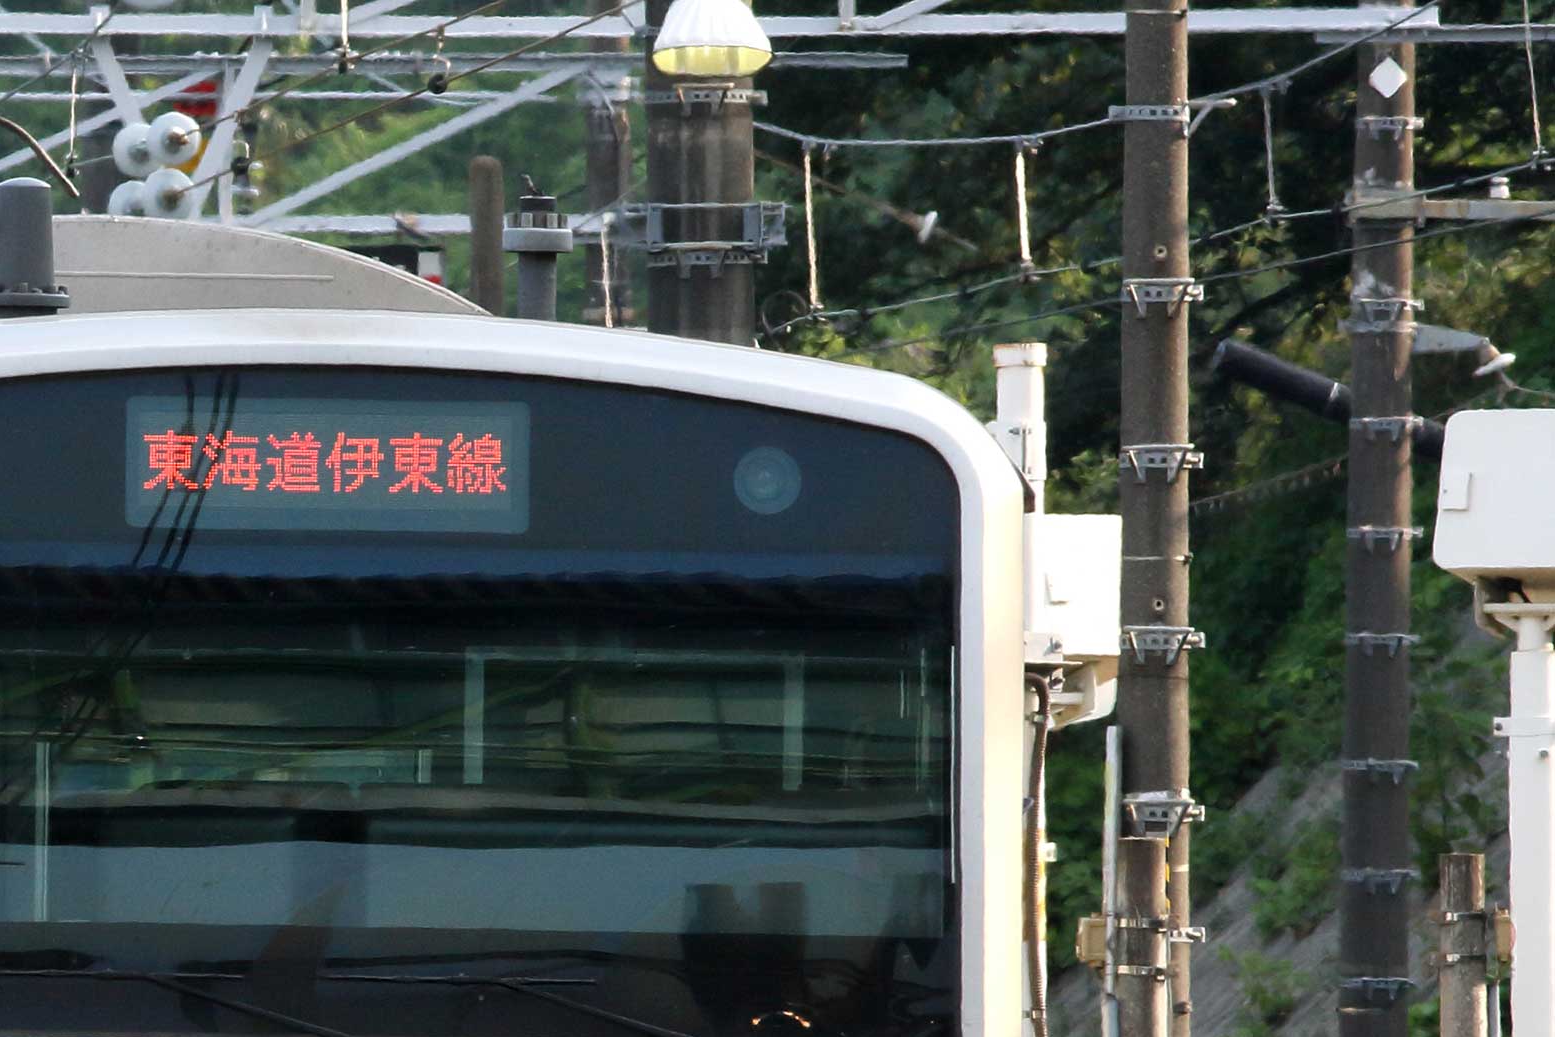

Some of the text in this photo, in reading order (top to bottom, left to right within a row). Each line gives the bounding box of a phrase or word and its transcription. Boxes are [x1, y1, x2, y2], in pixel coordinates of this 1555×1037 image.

[143, 430, 507, 494] 東海道伊東線
